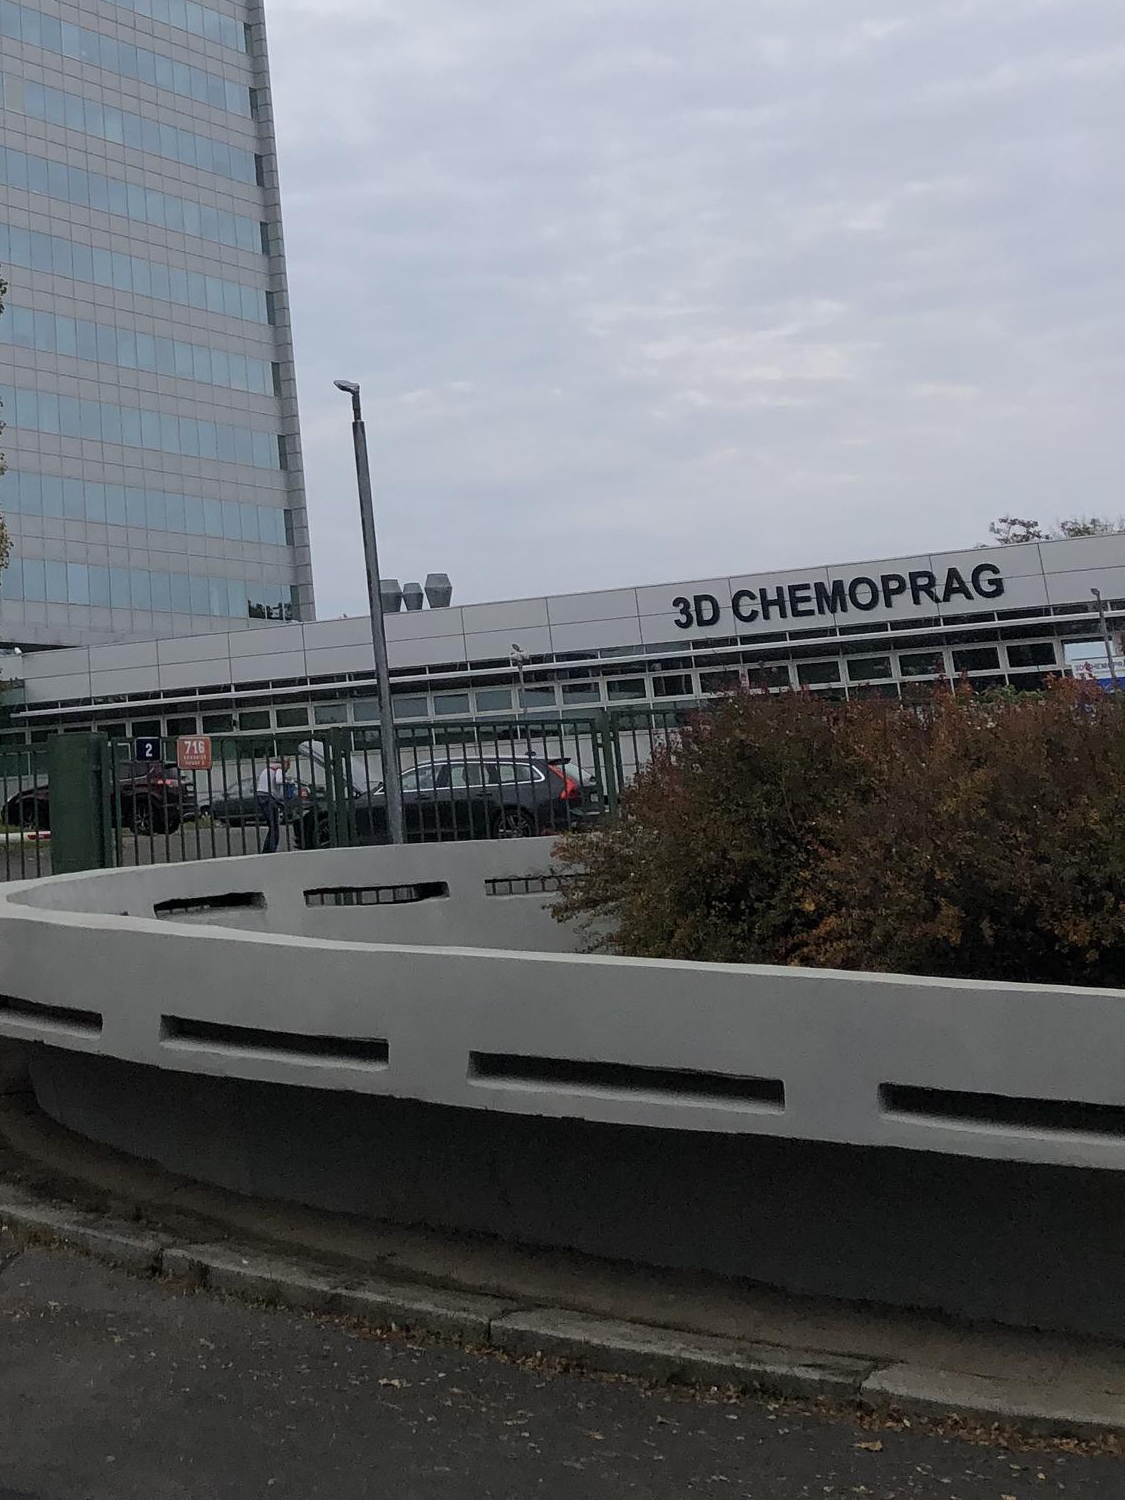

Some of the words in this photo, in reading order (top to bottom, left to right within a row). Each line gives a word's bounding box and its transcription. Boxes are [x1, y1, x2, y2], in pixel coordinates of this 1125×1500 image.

[672, 593, 721, 630] 3D
[731, 563, 1005, 623] CHEMOPRAG
[145, 743, 153, 757] 2
[184, 740, 205, 754] 716
